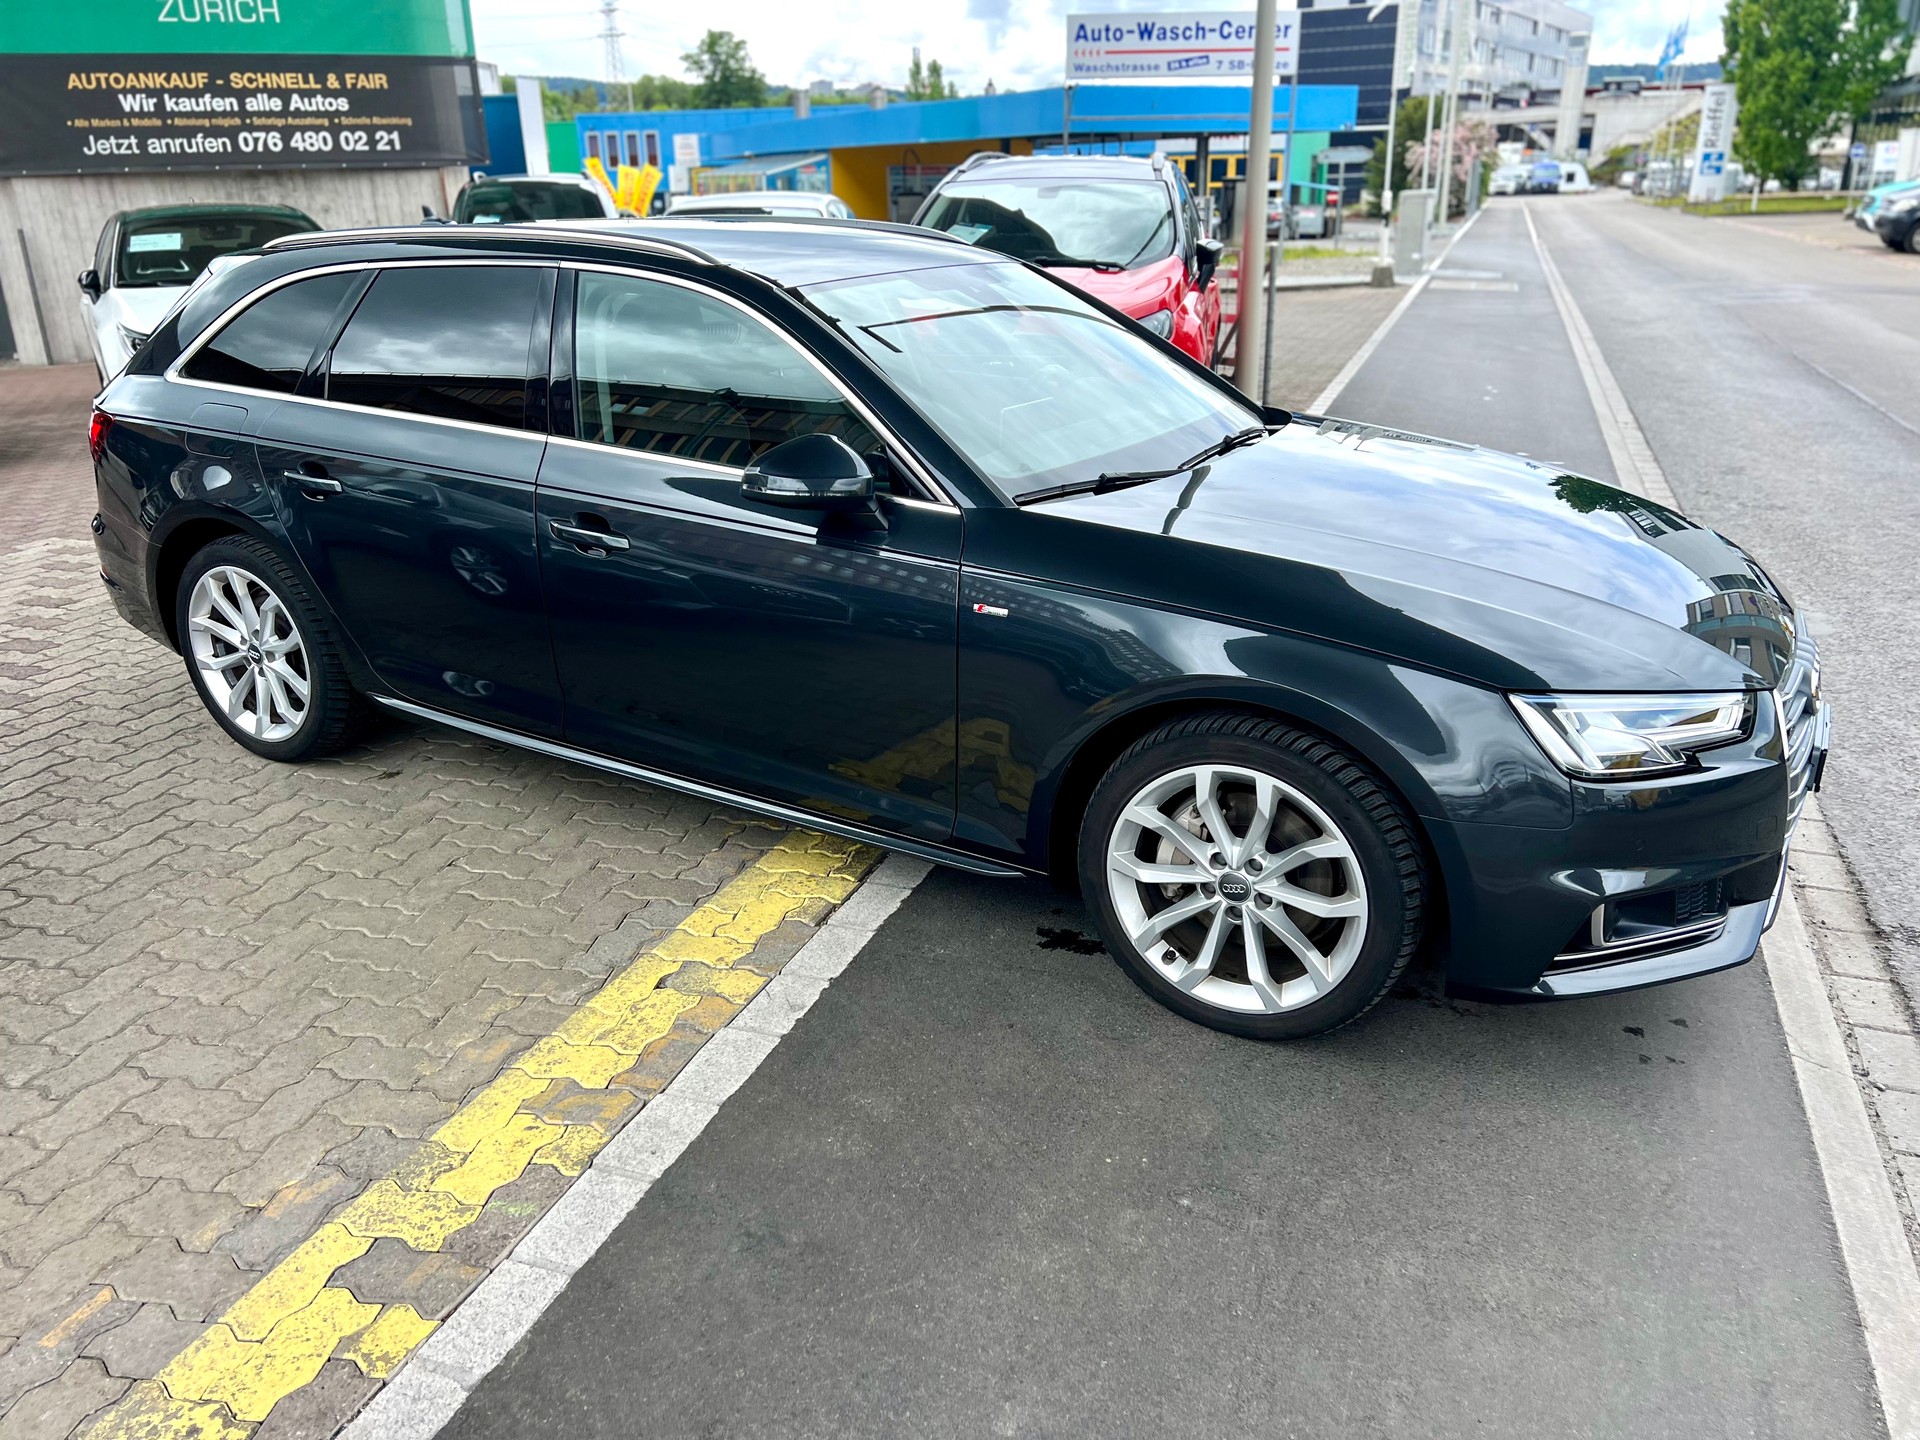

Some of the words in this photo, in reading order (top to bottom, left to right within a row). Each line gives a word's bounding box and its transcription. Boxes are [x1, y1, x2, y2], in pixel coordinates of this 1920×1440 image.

[1073, 61, 1160, 73] Waschstrasse
[1216, 60, 1223, 70] 7
[67, 72, 209, 90] AUTOANKAUF
[229, 72, 321, 89] SCHNELL
[326, 73, 341, 89] &
[344, 73, 389, 89] FAIR
[118, 93, 157, 112] Wir
[163, 93, 239, 112] kaufen
[244, 93, 283, 111] alle
[289, 93, 350, 112] Autos
[83, 134, 140, 155] Jetzt
[146, 133, 231, 154] anrufen
[238, 131, 283, 152] 076
[289, 131, 333, 152] 480
[339, 130, 370, 151] 02
[374, 130, 401, 151] 21
